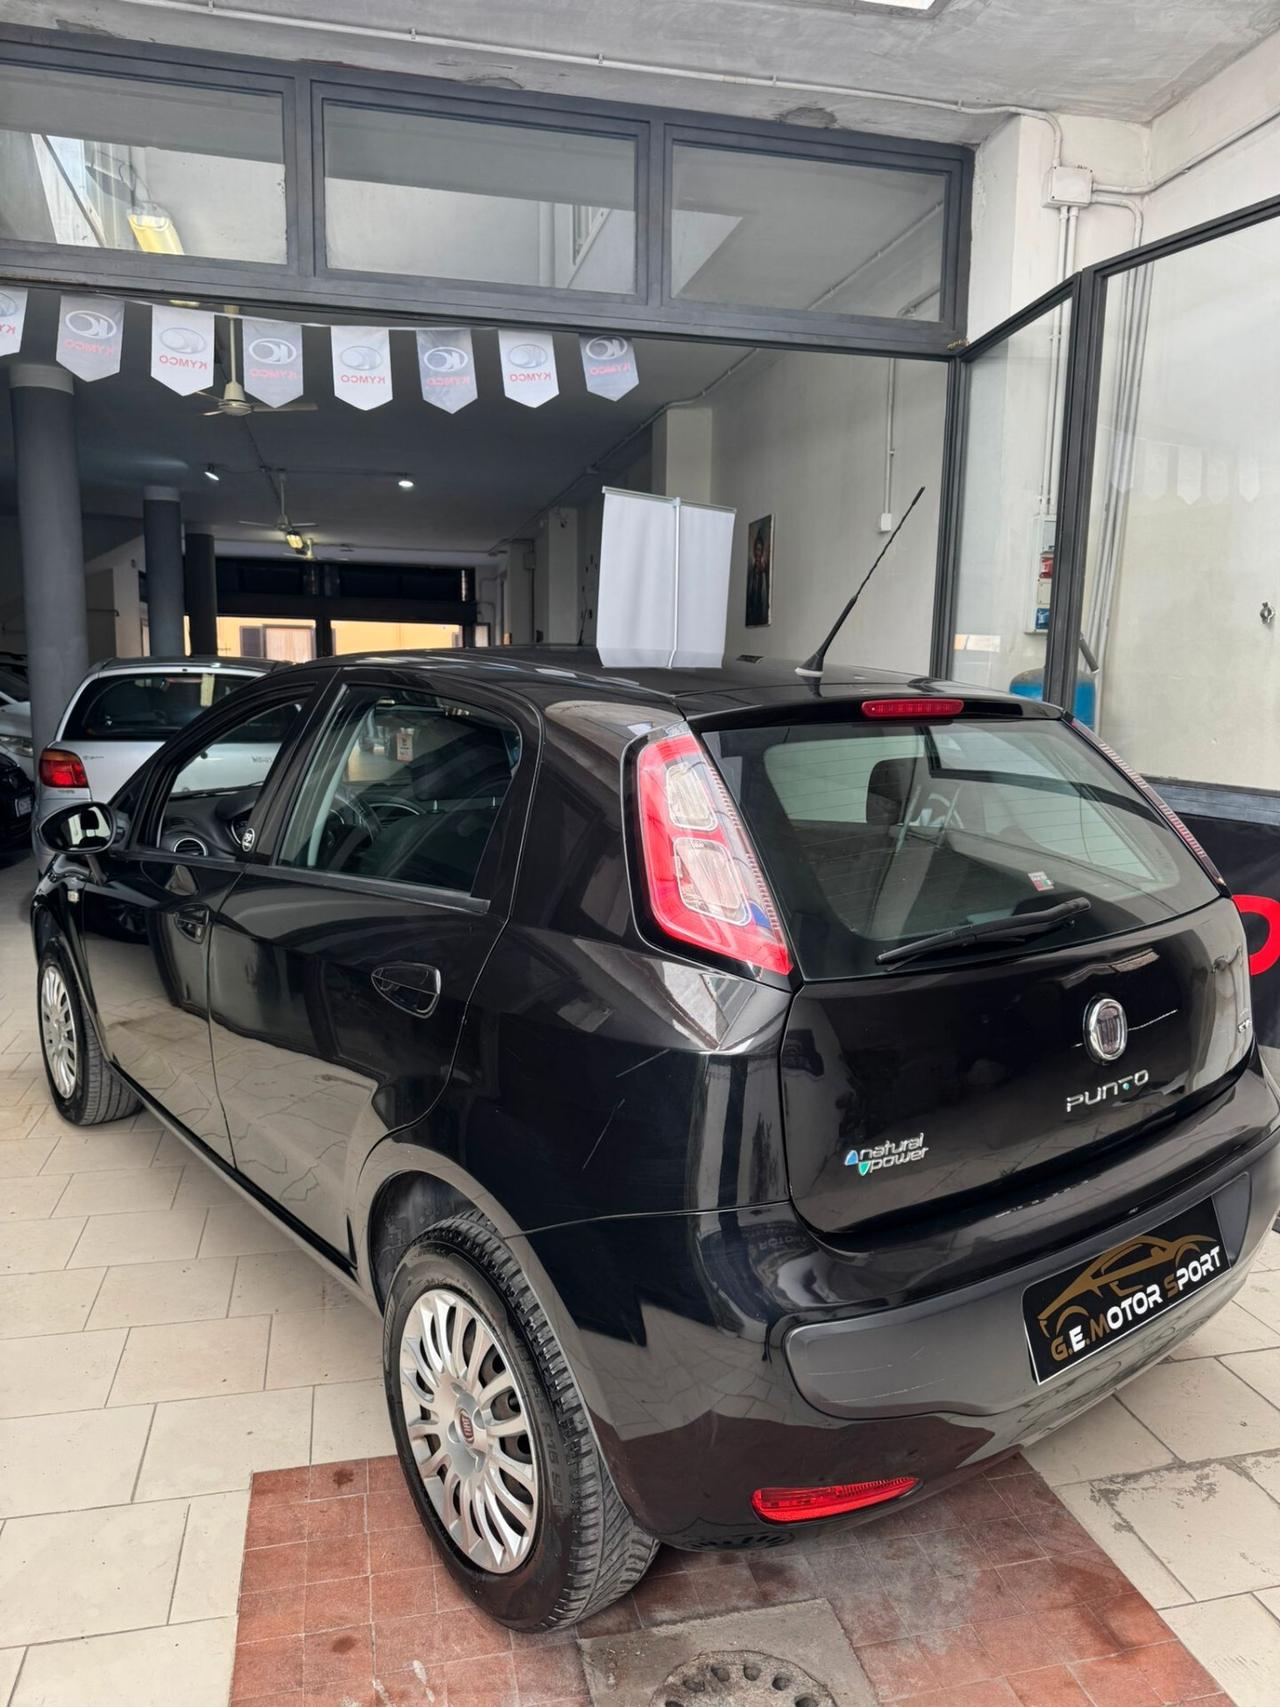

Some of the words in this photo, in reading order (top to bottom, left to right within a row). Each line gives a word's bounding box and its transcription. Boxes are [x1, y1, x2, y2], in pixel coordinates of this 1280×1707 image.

[859, 1132, 925, 1161] natural
[868, 1147, 930, 1174] power
[1163, 1245, 1221, 1299] SPORT
